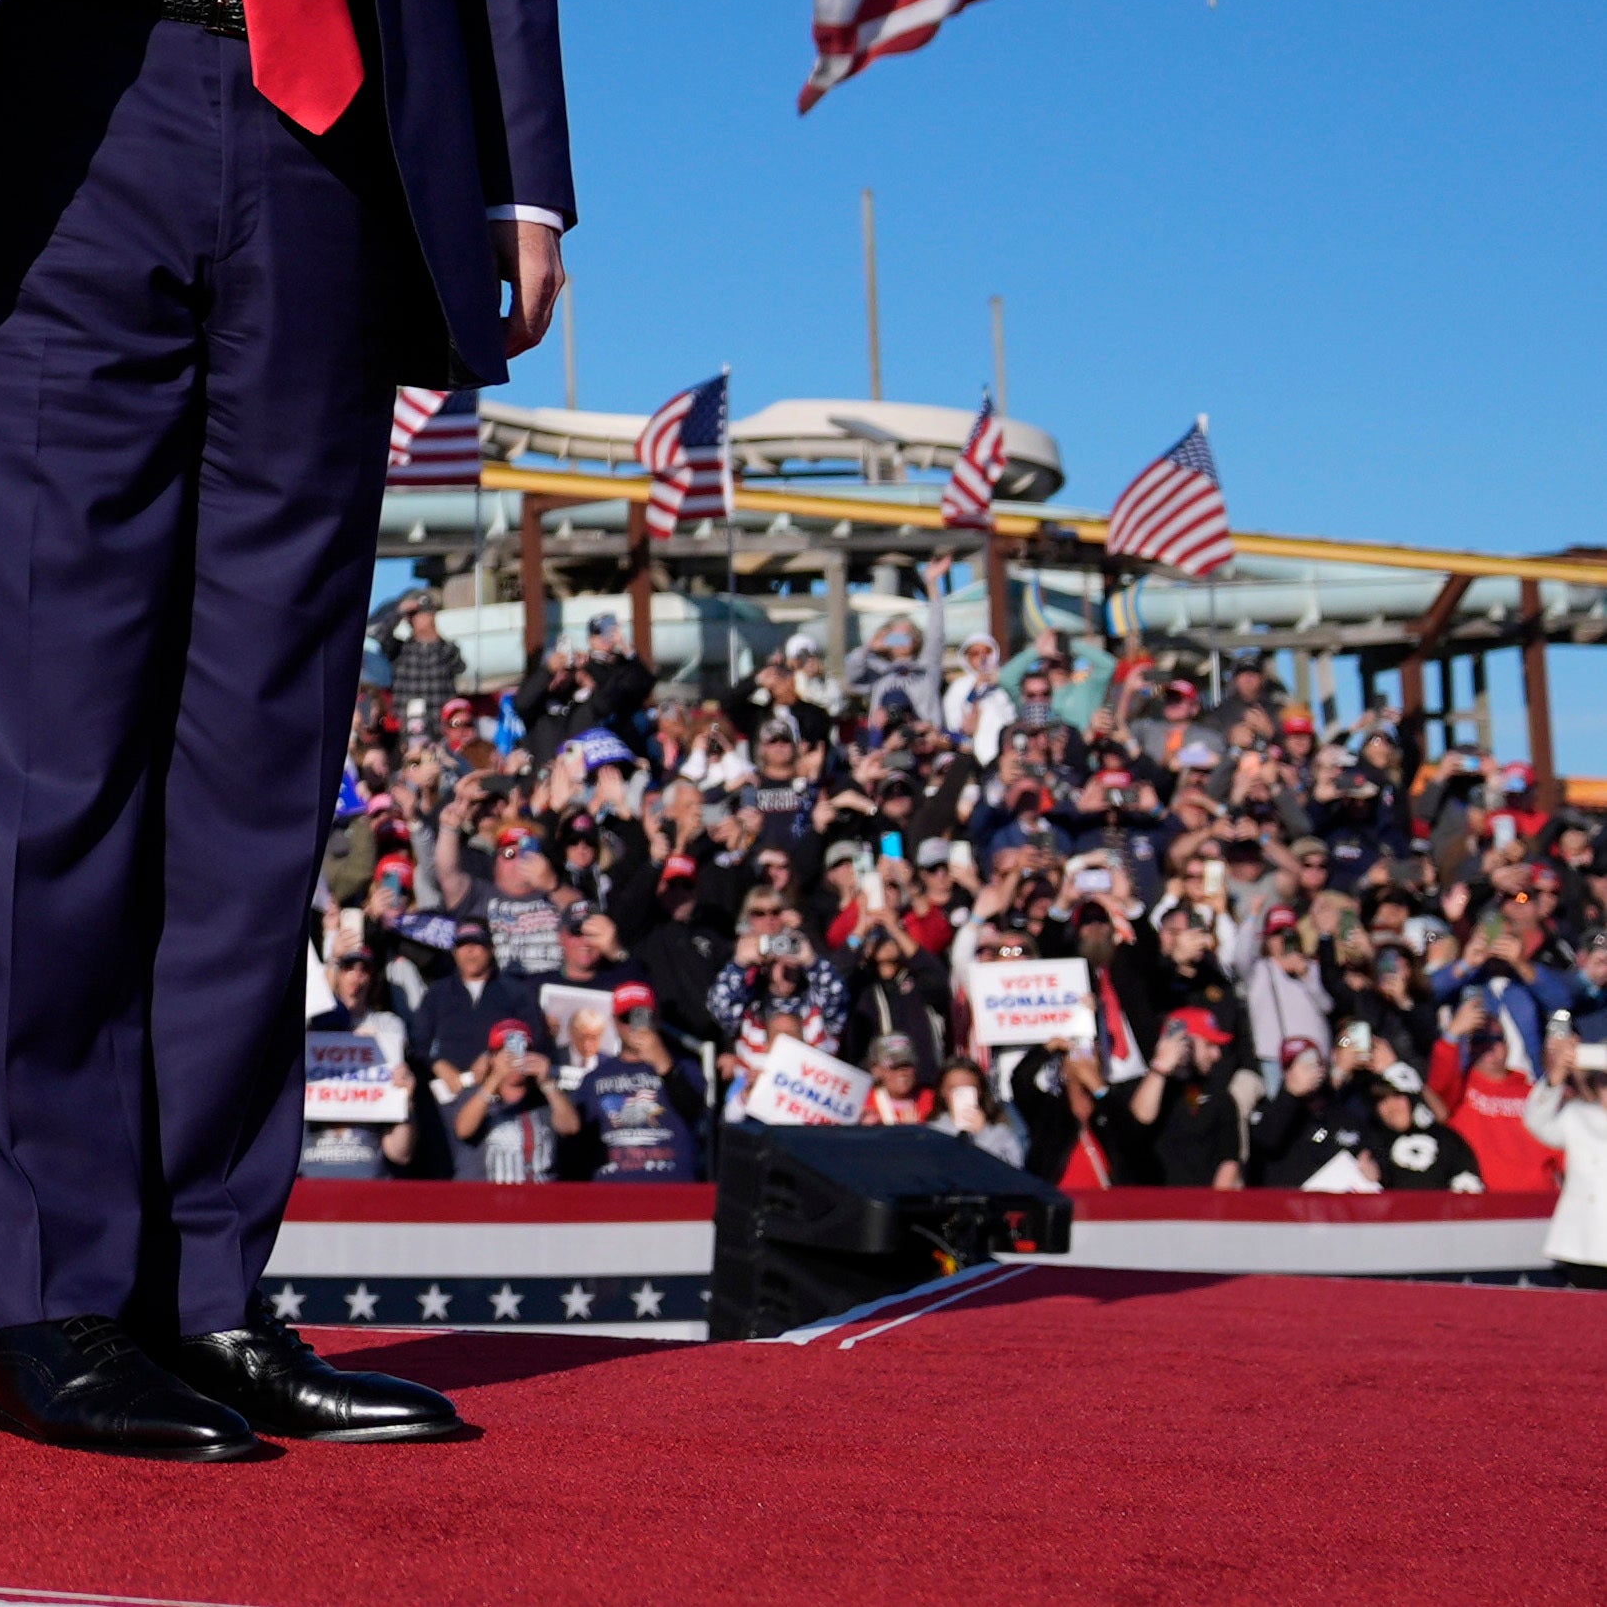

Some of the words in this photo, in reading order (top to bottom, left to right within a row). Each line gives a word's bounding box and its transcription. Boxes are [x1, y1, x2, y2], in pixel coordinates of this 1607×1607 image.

[999, 975, 1059, 989] VOTE
[985, 991, 1078, 1009] DONALD
[996, 1011, 1072, 1027] TRUMP
[312, 1046, 374, 1063] VOTE
[802, 1061, 853, 1095] VOTE
[774, 1073, 854, 1117] DONALD
